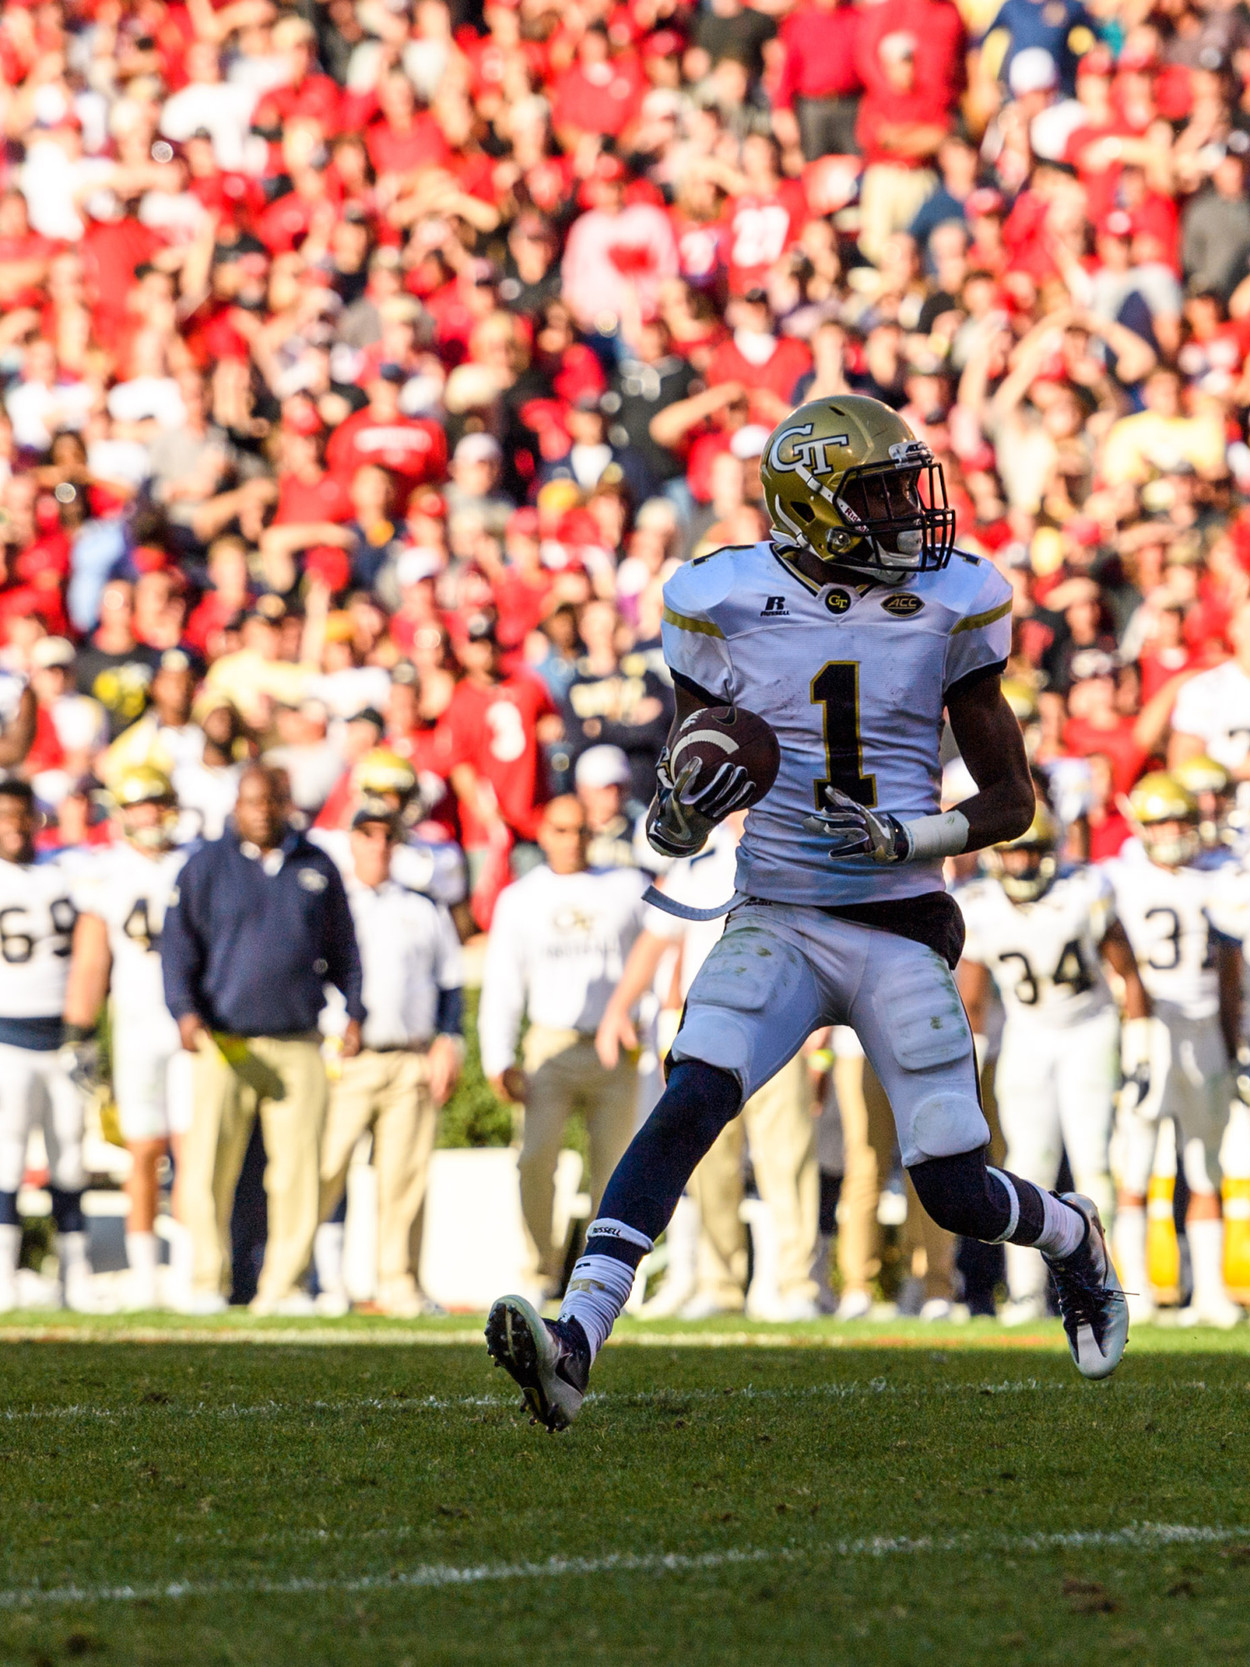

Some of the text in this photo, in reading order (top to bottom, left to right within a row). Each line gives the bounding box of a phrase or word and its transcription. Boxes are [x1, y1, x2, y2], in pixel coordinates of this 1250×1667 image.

[769, 422, 849, 476] GT
[828, 595, 848, 609] GT
[887, 597, 917, 608] ACC
[810, 660, 878, 811] 1
[0, 896, 79, 963] 69
[999, 938, 1092, 1004] 34
